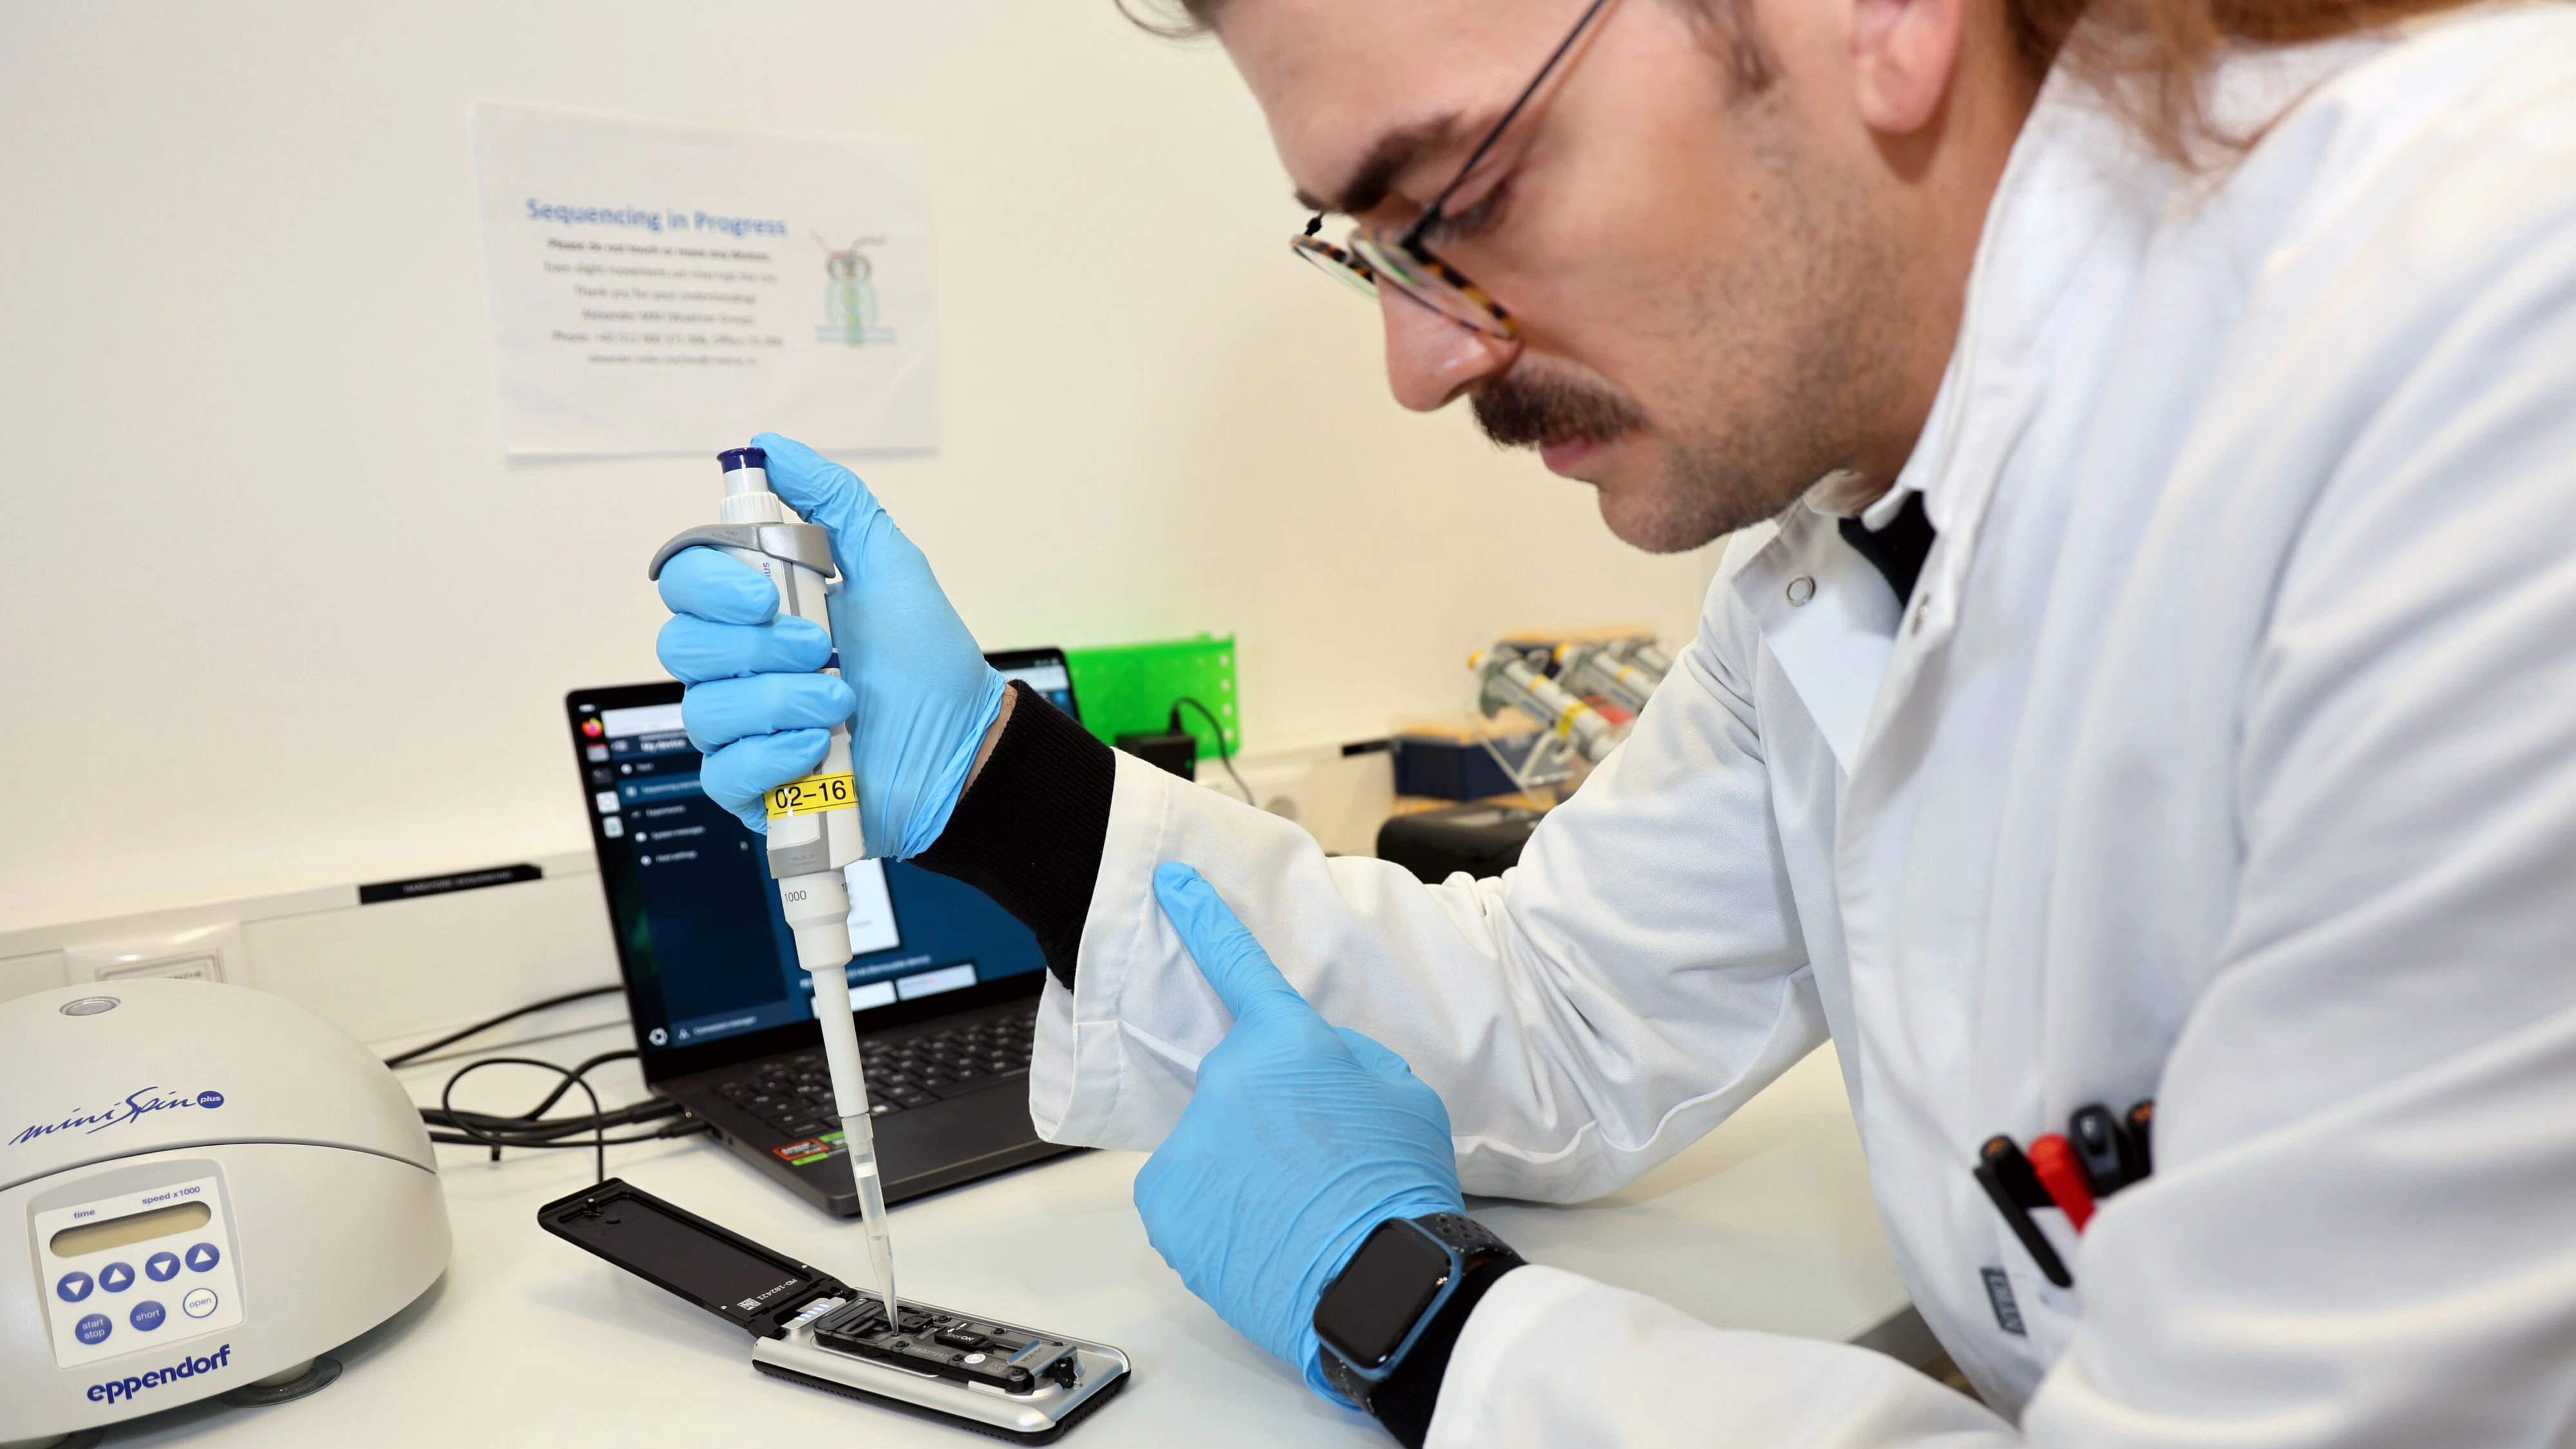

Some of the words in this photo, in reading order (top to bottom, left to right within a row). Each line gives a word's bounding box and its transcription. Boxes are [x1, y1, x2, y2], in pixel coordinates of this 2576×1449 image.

[526, 197, 664, 234] Sequencing
[667, 207, 690, 231] in
[694, 209, 789, 239] Progress
[775, 779, 847, 809] 02-16
[784, 890, 807, 903] 1000
[200, 1095, 222, 1104] plus
[142, 1192, 171, 1206] speed
[73, 1208, 96, 1219] time
[189, 1296, 213, 1309] open
[136, 1309, 160, 1321] short
[82, 1318, 104, 1330] start
[84, 1329, 106, 1340] stop
[87, 1343, 231, 1405] eppendorf
